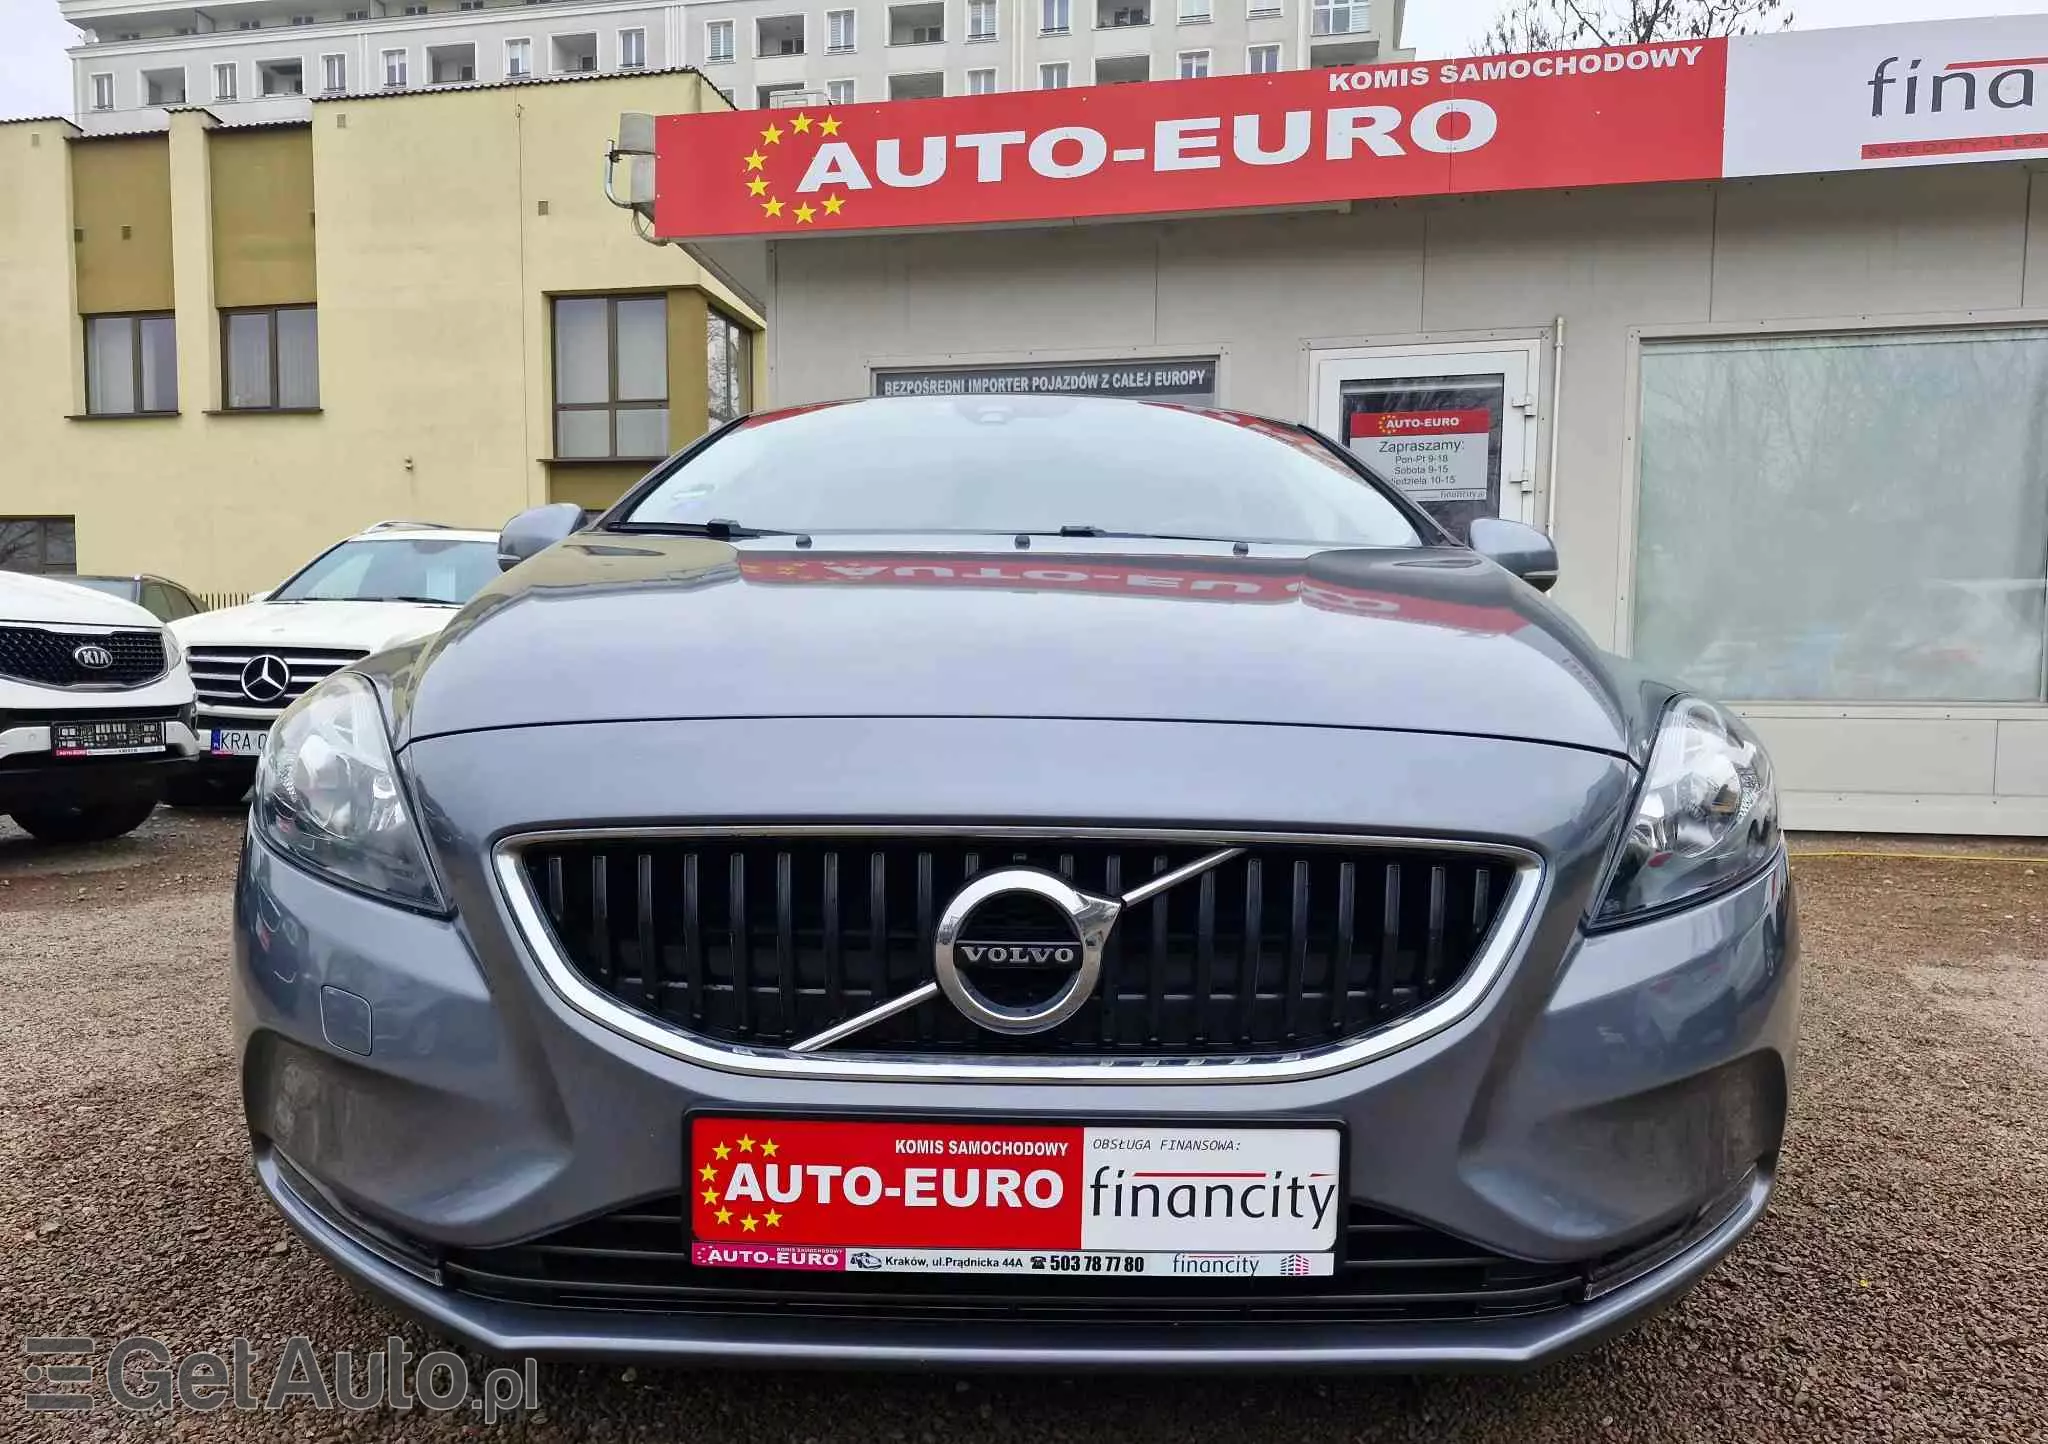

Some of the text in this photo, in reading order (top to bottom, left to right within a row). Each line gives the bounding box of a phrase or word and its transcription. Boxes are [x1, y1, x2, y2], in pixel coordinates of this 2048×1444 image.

[1329, 45, 1703, 92] KOMIS SAMOCHODOWY
[796, 98, 1498, 193] AUTO-EURO
[884, 369, 1206, 396] BEZPOŚREDNI IMPORTER POJAZDÓW Z CAŁEJ EUROPY
[1386, 417, 1460, 429] AUTO-EURO
[1379, 440, 1465, 454] Zapraszamy:
[1394, 465, 1449, 475] Sobota 9-15
[1431, 474, 1457, 484] 10-15
[83, 650, 110, 665] KIA
[221, 731, 251, 750] KRA
[960, 946, 1074, 963] VOLVO
[895, 1139, 1069, 1157] KOMIS SAMOCHODOWY
[1092, 1138, 1242, 1151] OBSŁUGA FINANSOWA:
[724, 1162, 1065, 1209] AUTO-EURO
[1090, 1165, 1336, 1230] financity
[707, 1249, 839, 1266] AUTO-EURO
[885, 1256, 1024, 1269] Kraków, ul.Prądnicka 44A
[1050, 1255, 1145, 1273] 503 78 77 80
[1172, 1253, 1260, 1276] financity
